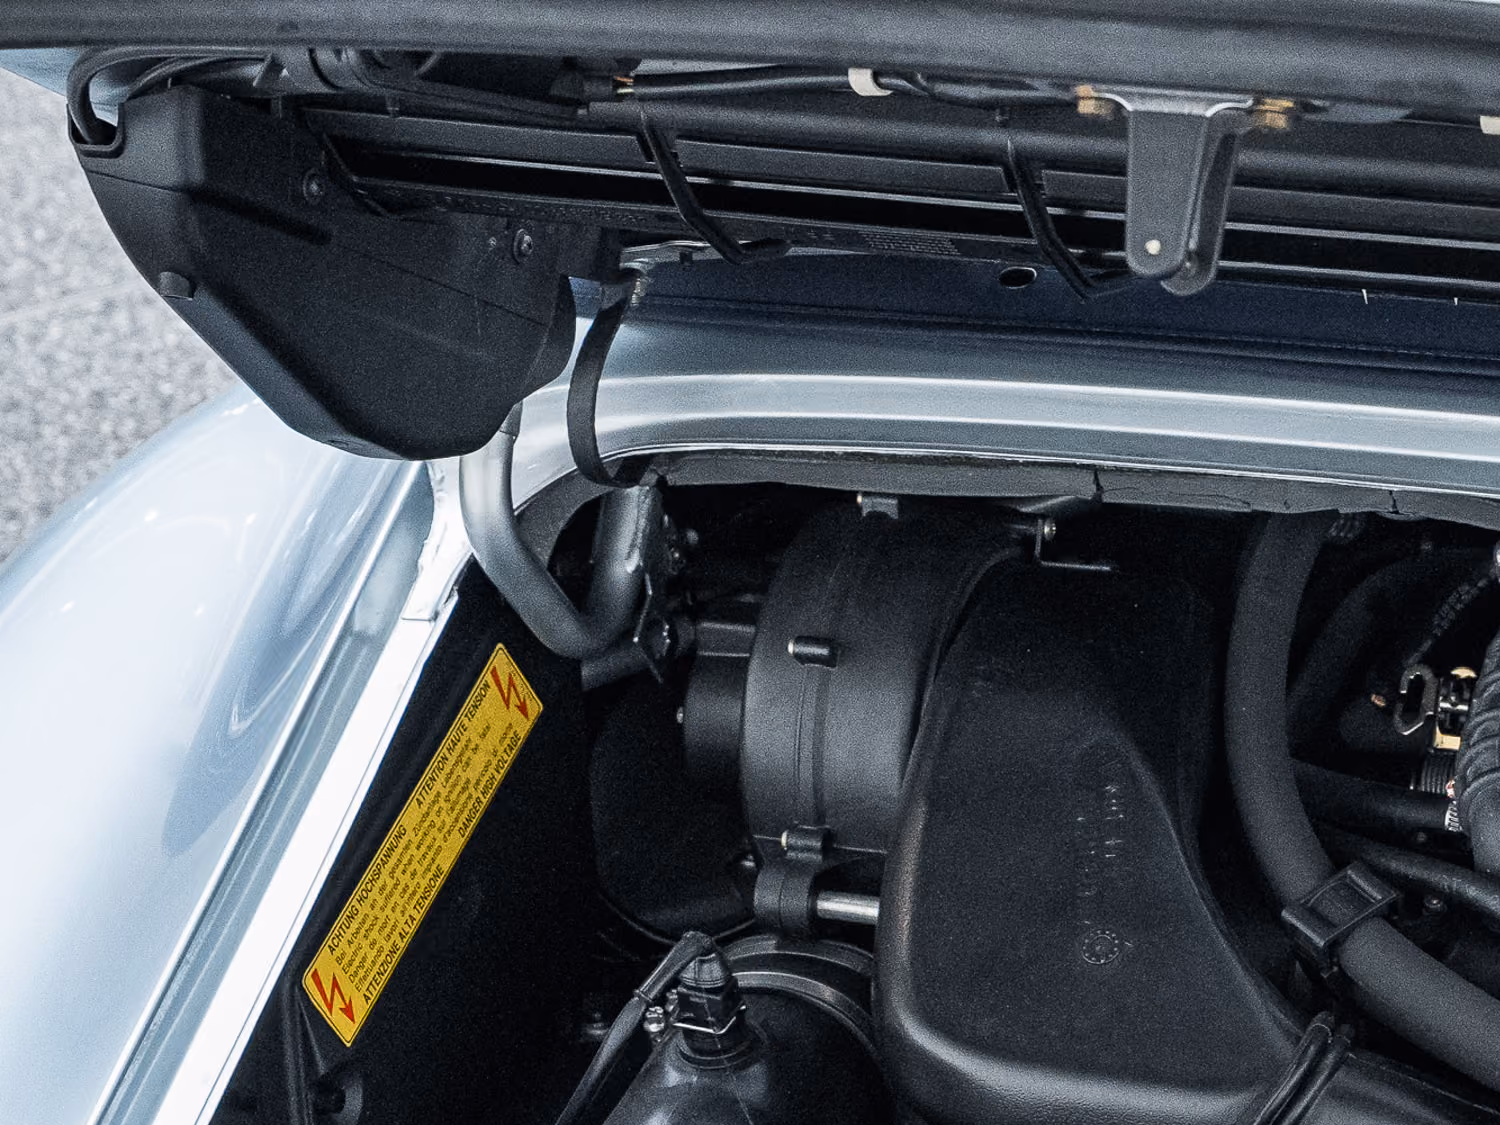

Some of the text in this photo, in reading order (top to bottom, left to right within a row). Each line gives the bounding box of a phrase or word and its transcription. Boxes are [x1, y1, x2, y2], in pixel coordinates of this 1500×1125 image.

[414, 679, 491, 809] ATTENTION HAUTE TENSION
[457, 794, 483, 839] DANGER
[479, 771, 497, 800] HIGH
[493, 728, 521, 776] VOLTAGE
[327, 822, 407, 957] ACHTUNG HOCHSPANNUNG
[335, 947, 347, 966] Bei
[345, 909, 369, 949] Arbeiten
[367, 895, 378, 911] an
[376, 877, 388, 897] der
[341, 939, 363, 975] Electric
[362, 912, 379, 941] shock
[399, 851, 415, 877] when
[414, 817, 436, 853] working
[348, 950, 370, 986] Danger
[367, 936, 377, 951] de
[376, 913, 390, 936] mort
[389, 898, 399, 914] en
[398, 881, 409, 899] cas
[408, 866, 418, 881] de
[361, 863, 444, 1005] ATTENZIONE ALTA TENSIONE
